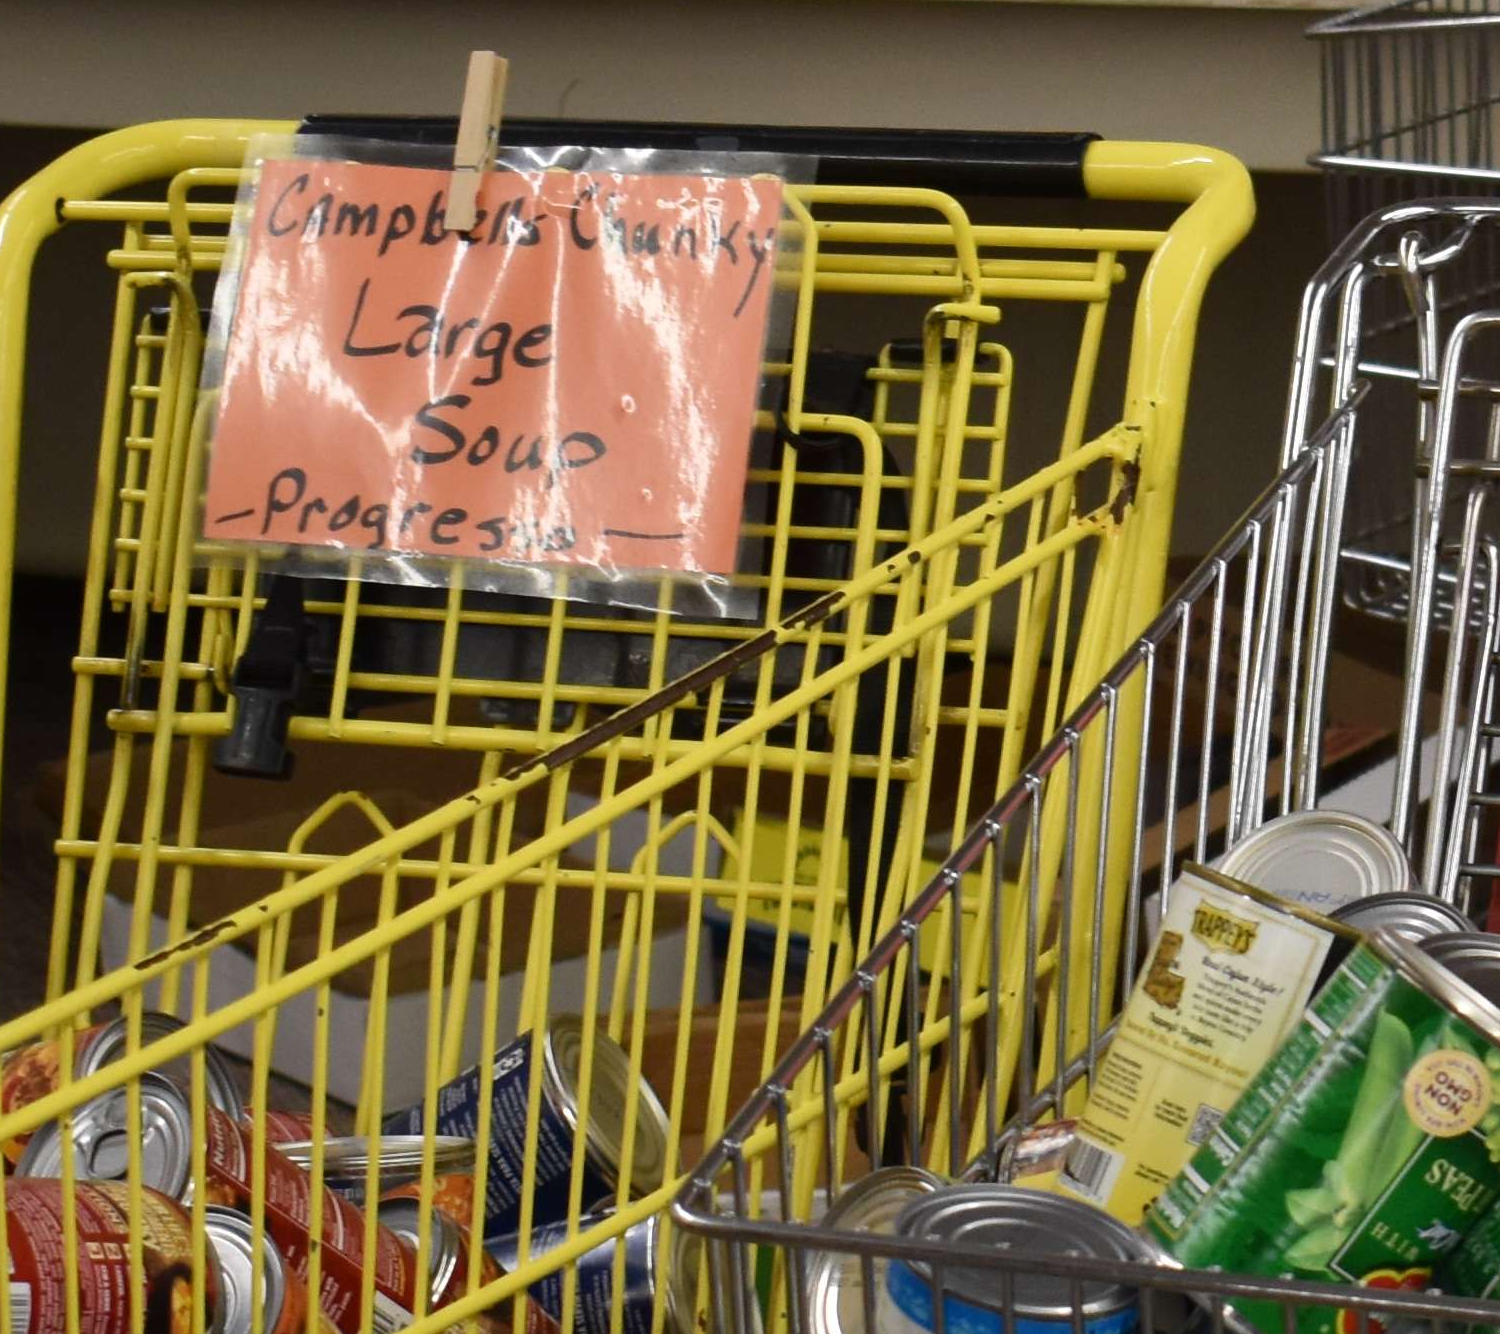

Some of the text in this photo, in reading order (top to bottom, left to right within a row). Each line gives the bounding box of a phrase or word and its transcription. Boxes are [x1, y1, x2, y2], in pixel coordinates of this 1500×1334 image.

[343, 278, 554, 386] Large
[410, 394, 607, 492] Soup
[1426, 1091, 1465, 1119] NON
